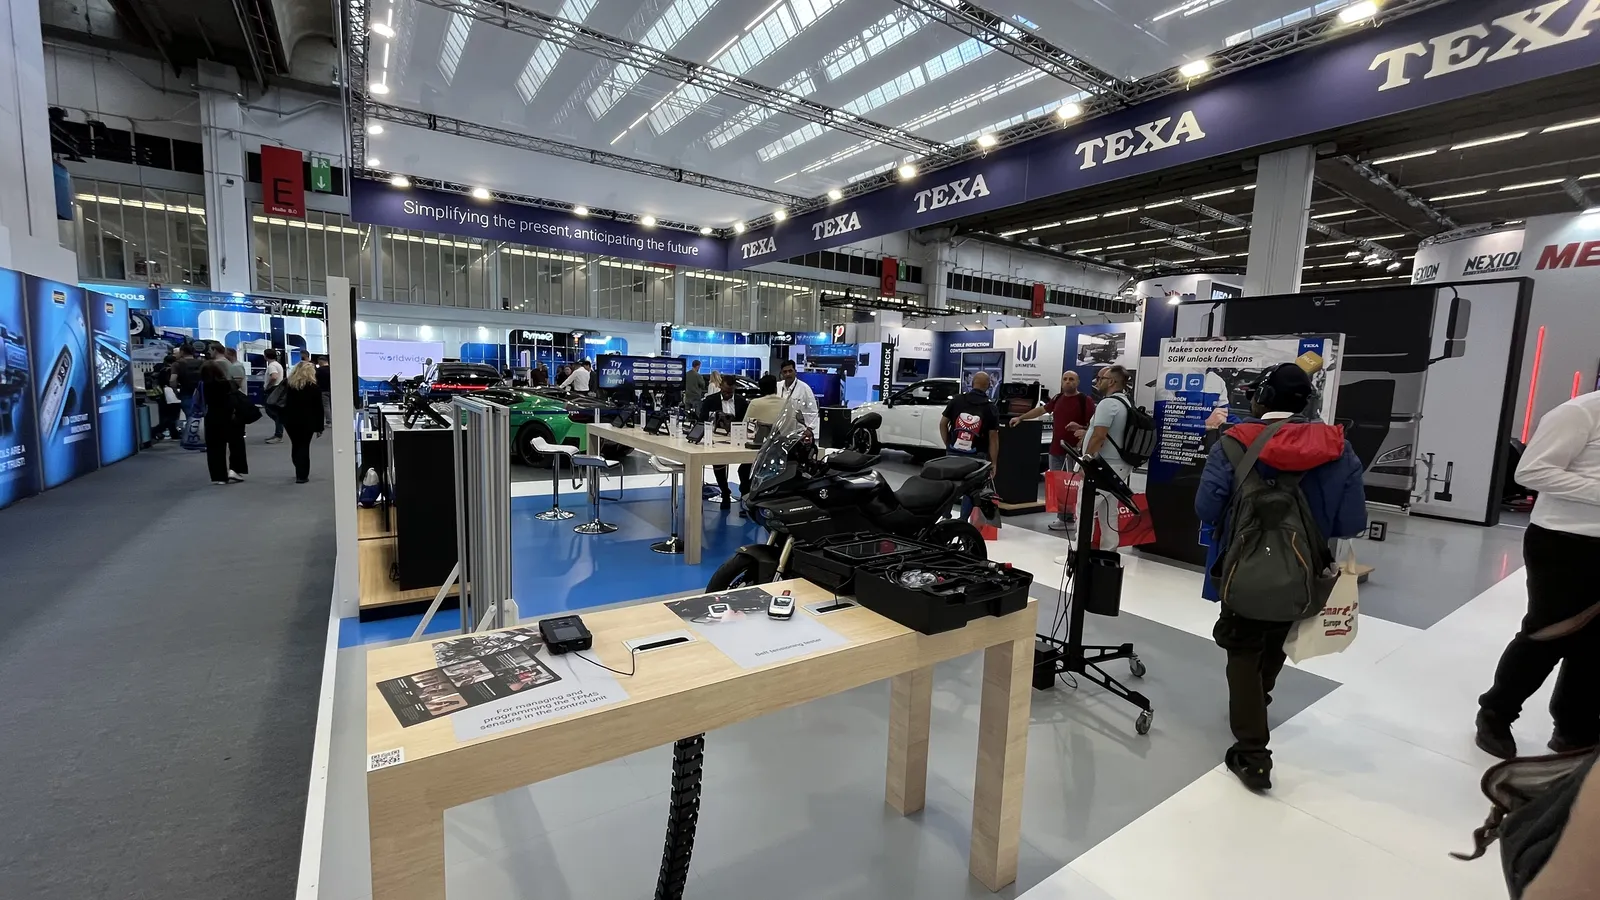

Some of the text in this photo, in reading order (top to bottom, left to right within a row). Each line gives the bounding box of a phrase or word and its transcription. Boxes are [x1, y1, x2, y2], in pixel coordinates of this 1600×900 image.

[1075, 110, 1206, 171] TEXA
[273, 178, 294, 206] E
[914, 174, 991, 214] TEXA
[403, 200, 699, 257] Simplifying the present, anticipating the future
[812, 211, 862, 241] TEXA
[741, 236, 777, 260] TEXA
[378, 355, 424, 364] worldwide
[1167, 355, 1254, 363] SGW unlock functions
[1168, 344, 1238, 354] Makes covered by
[602, 368, 622, 376] TEXA
[610, 360, 622, 368] Try
[883, 348, 891, 376] CHECK
[607, 377, 625, 385] here!
[1160, 454, 1193, 462] VOLKSWAGEN
[1323, 618, 1341, 628] Europe
[480, 716, 522, 730] sensors
[536, 708, 552, 716] the
[554, 699, 588, 712] control
[589, 695, 607, 704] unit
[483, 691, 600, 725] programming the TPMS
[496, 689, 584, 714] For managing and
